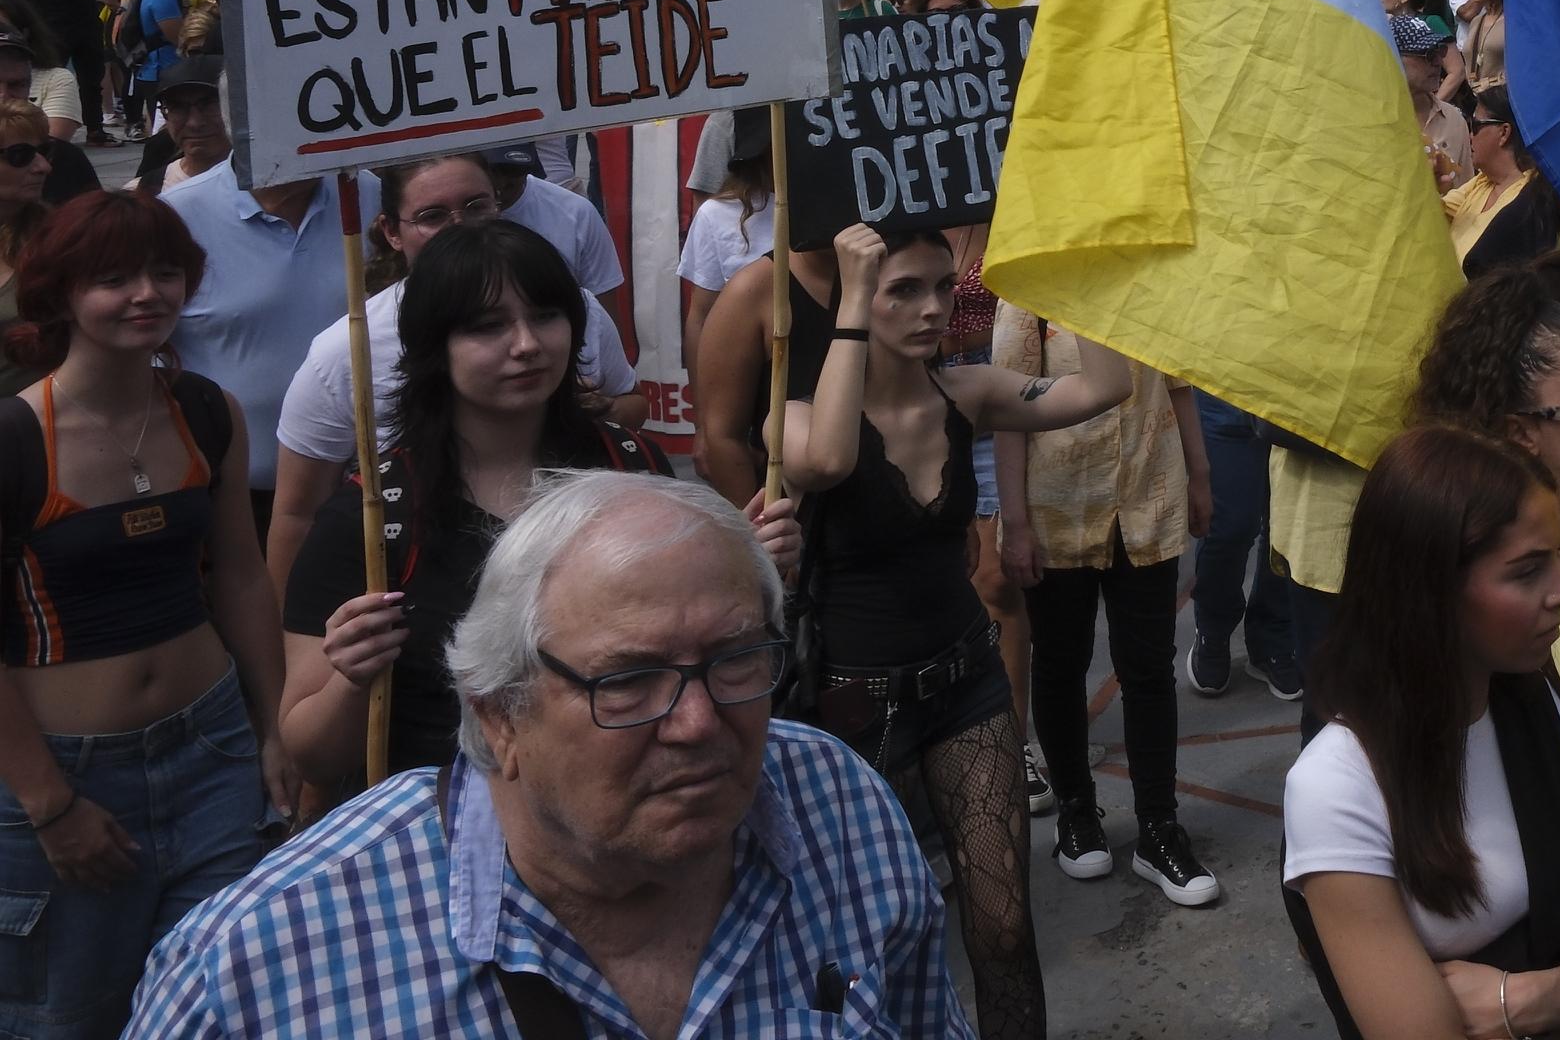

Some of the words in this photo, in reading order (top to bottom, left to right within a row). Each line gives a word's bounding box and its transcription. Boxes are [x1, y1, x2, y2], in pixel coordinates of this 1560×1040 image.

[297, 41, 458, 133] QUE
[461, 26, 538, 104] EL
[840, 13, 1005, 85] NARIAS
[804, 90, 861, 147] SE
[871, 69, 1012, 130] VENDE
